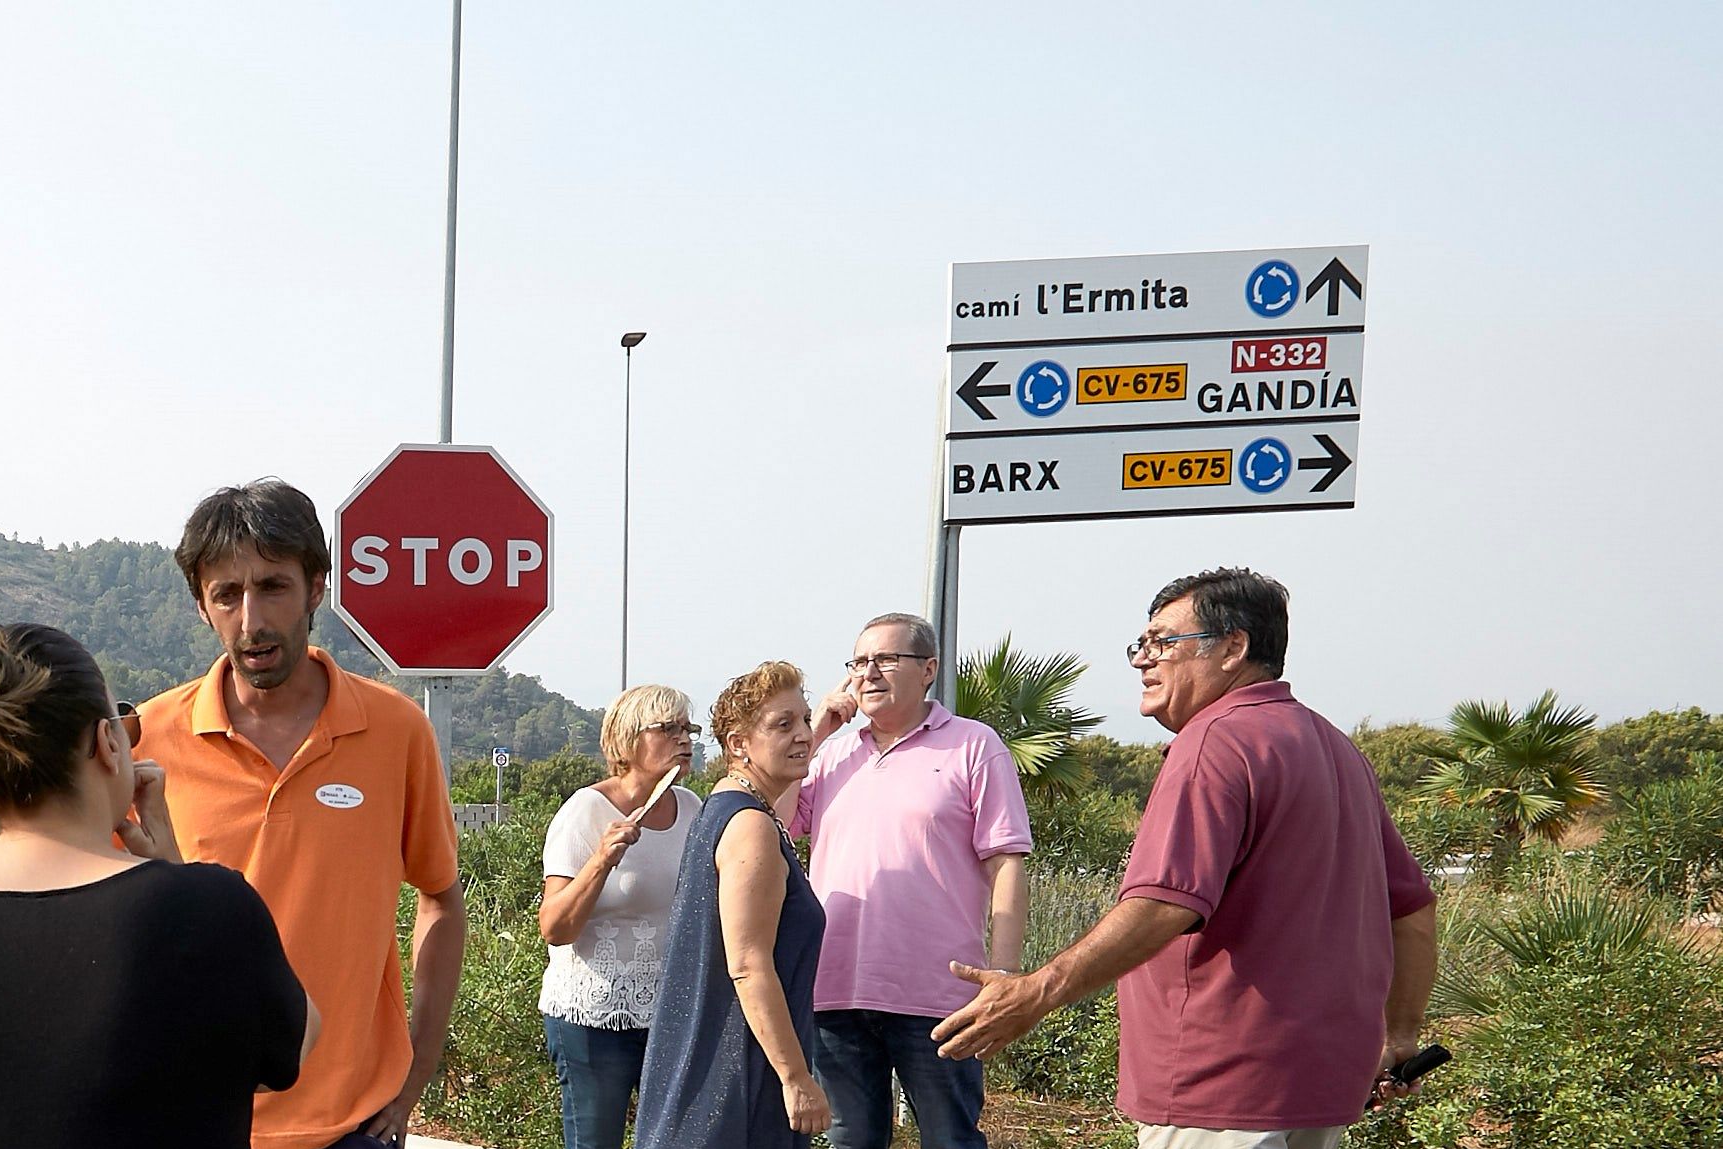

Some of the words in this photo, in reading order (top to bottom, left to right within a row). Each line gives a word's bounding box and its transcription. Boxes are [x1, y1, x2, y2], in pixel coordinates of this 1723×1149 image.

[956, 294, 1020, 319] camí
[1236, 342, 1323, 368] N-332
[1084, 372, 1181, 397] CV-675
[1197, 371, 1357, 414] GANDÍA
[953, 460, 1061, 495] BARX
[1129, 457, 1226, 483] CV-675
[346, 535, 544, 588] STOP
